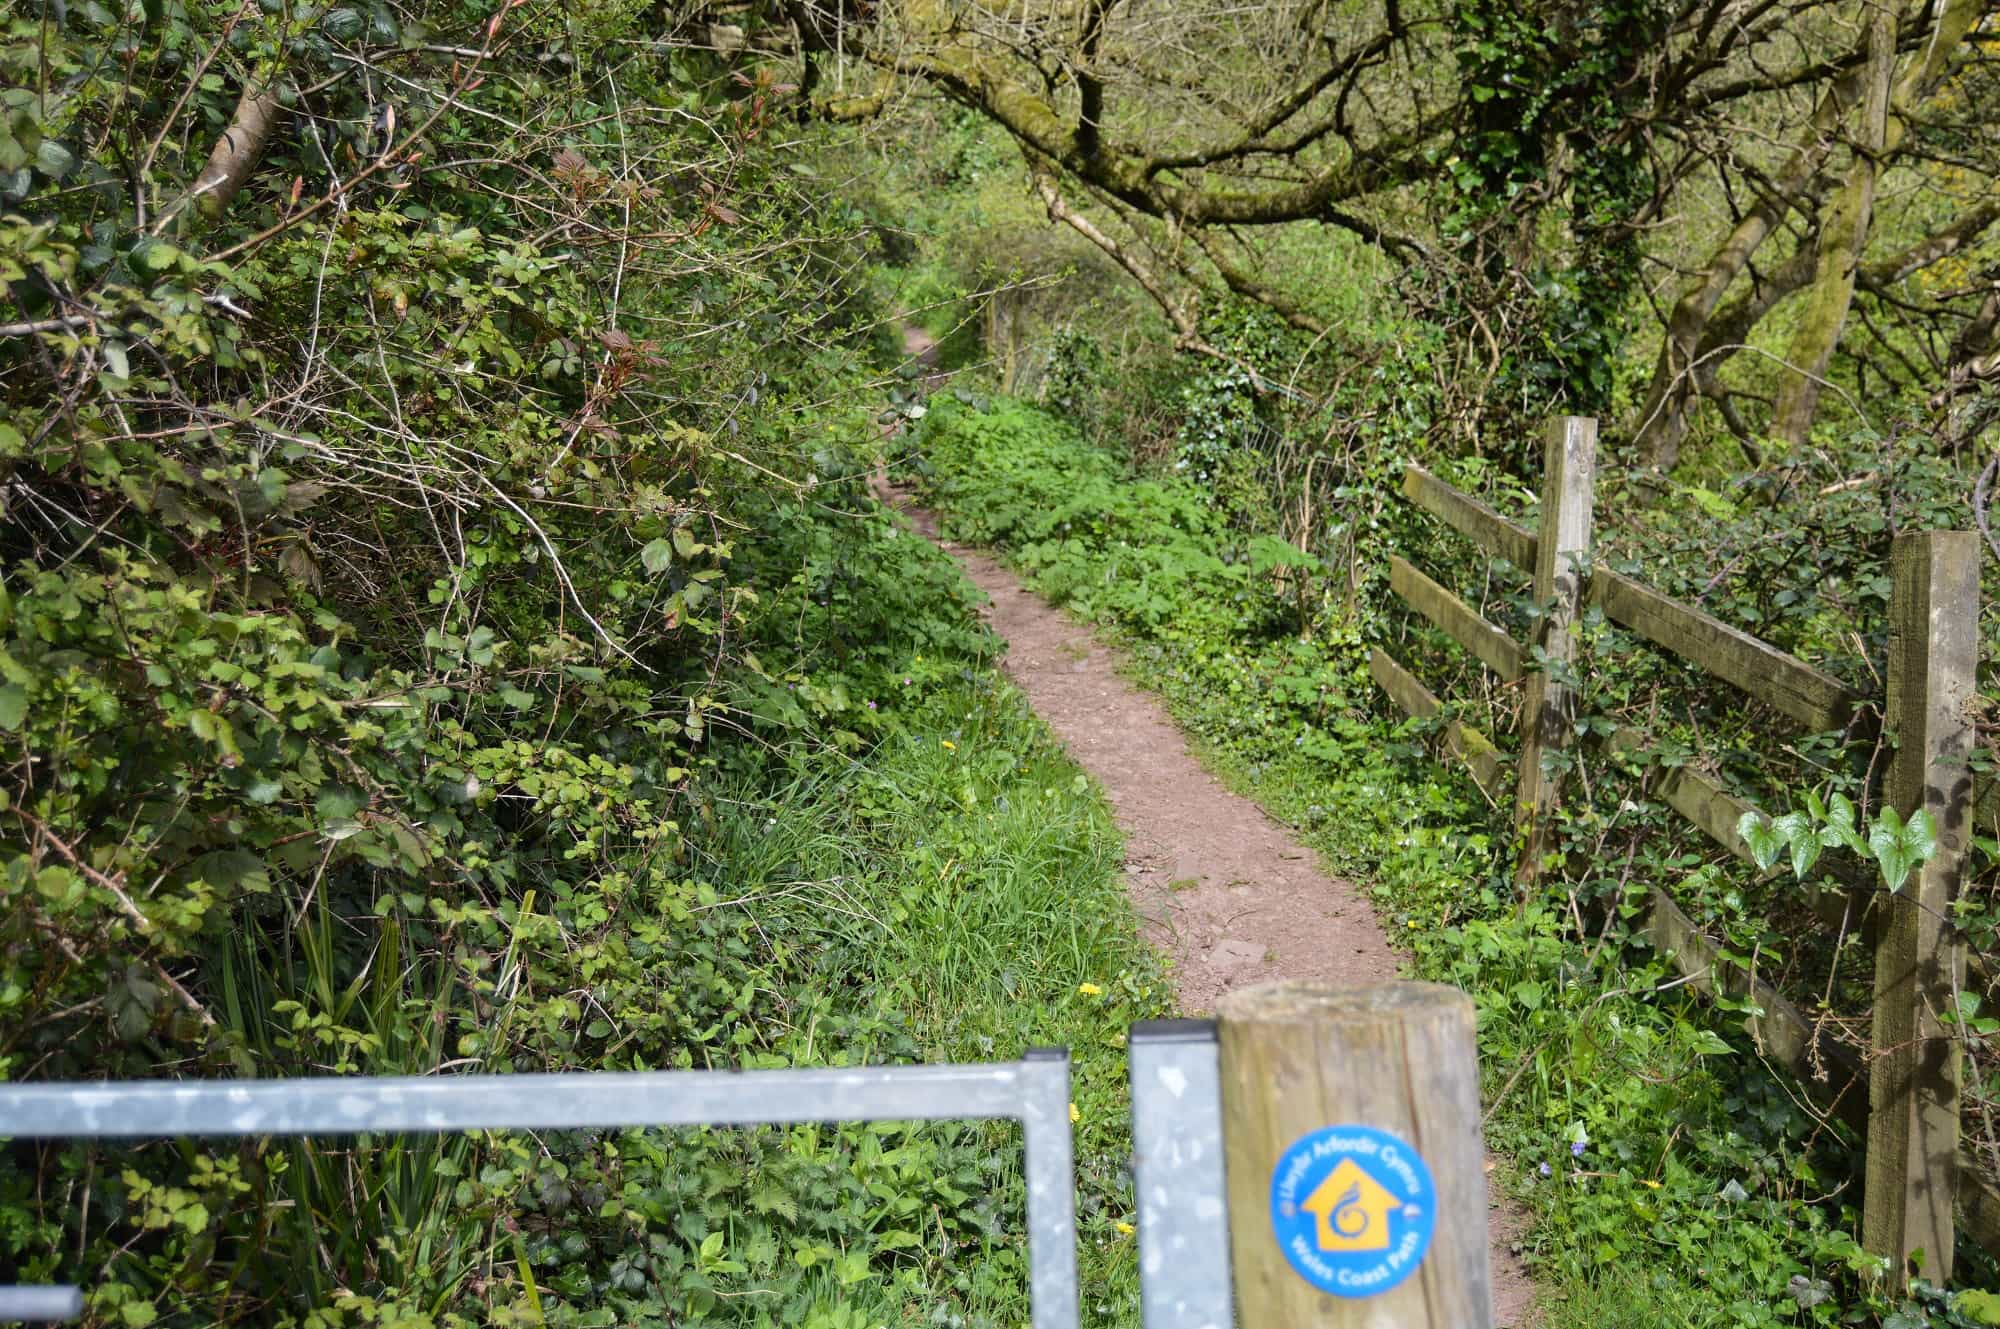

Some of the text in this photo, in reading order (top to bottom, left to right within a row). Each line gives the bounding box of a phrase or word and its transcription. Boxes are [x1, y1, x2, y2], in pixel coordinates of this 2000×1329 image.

[1380, 1145, 1420, 1195] Cymru
[1291, 1231, 1419, 1286] Wales Coast Path
